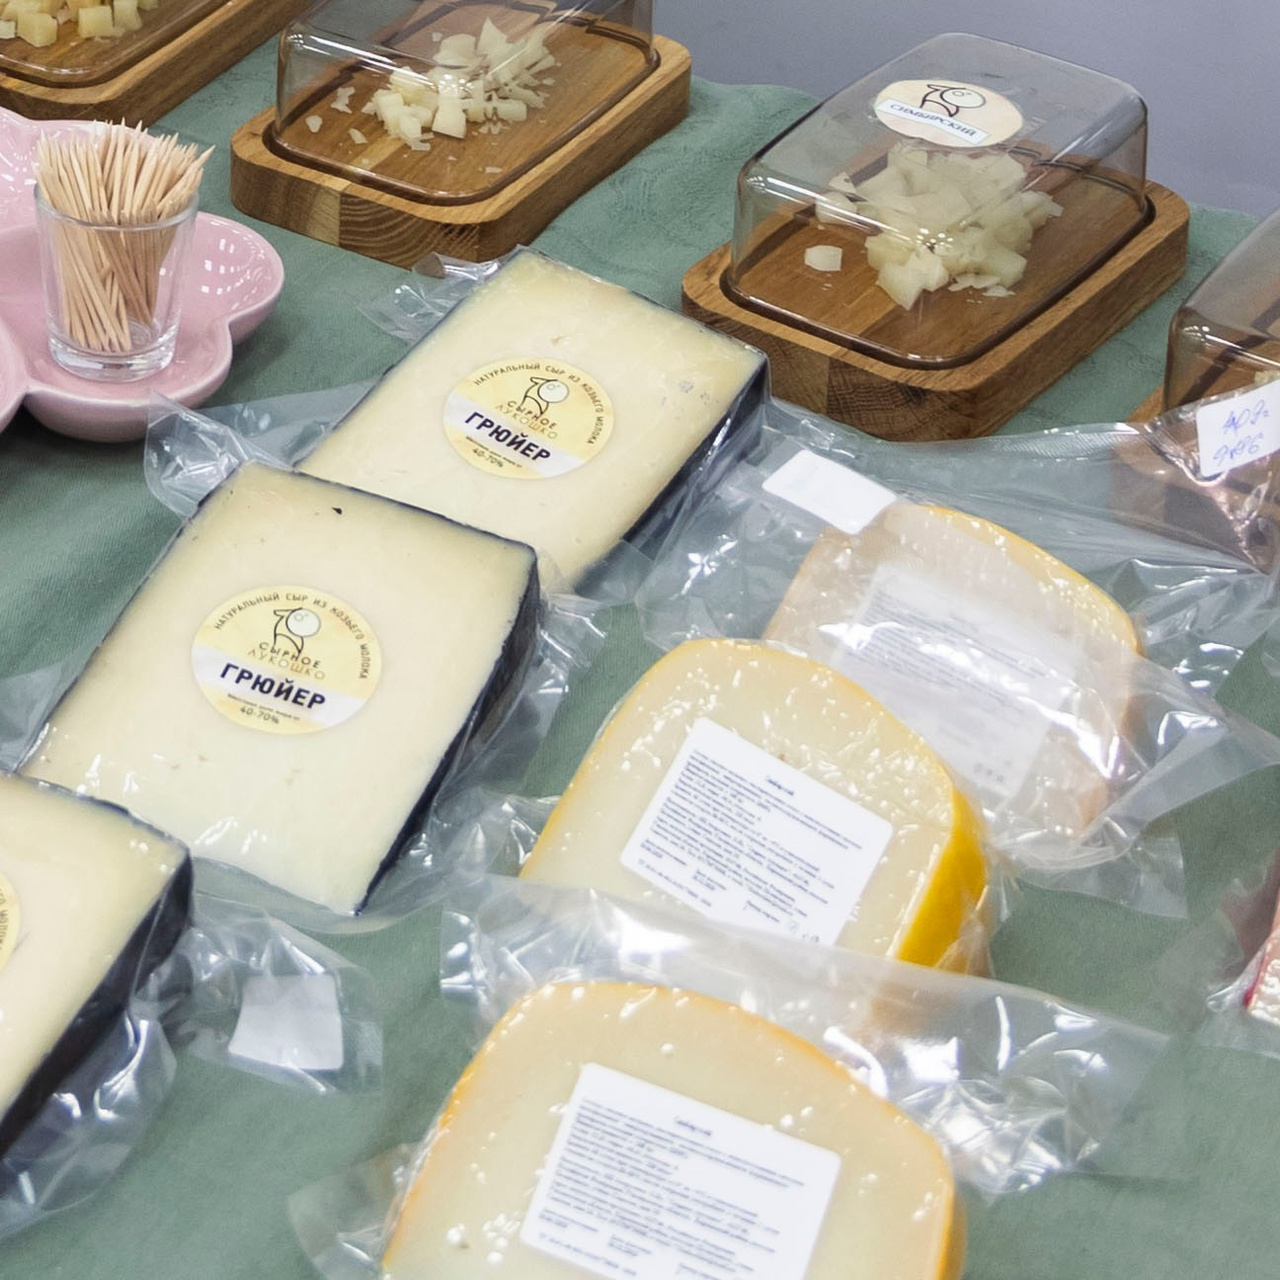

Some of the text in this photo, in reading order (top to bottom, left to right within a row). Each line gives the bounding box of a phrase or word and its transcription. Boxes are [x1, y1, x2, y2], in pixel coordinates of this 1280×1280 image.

[890, 103, 978, 137] СИМБИРСКИЙ
[474, 363, 605, 445] НАТУРАЛЬНЫЙ СЫР ИЗ КОЗЬЕГО МОЛОКА
[507, 400, 557, 429] СЫРНОЕ
[465, 412, 551, 461] ГРЮЙЕР
[495, 404, 557, 440] ЛУКОШКО
[472, 448, 504, 468] 40-70%
[214, 593, 371, 679] НАТУРАЛЬНЫЙ СЫР ИЗ КОЗЬЕГО МОЛОКА
[247, 648, 326, 680] ЛУКОШКО
[259, 641, 321, 668] СЫРНОЕ
[220, 662, 326, 709] ГРЮЙЕР
[240, 705, 280, 724] 40-70%
